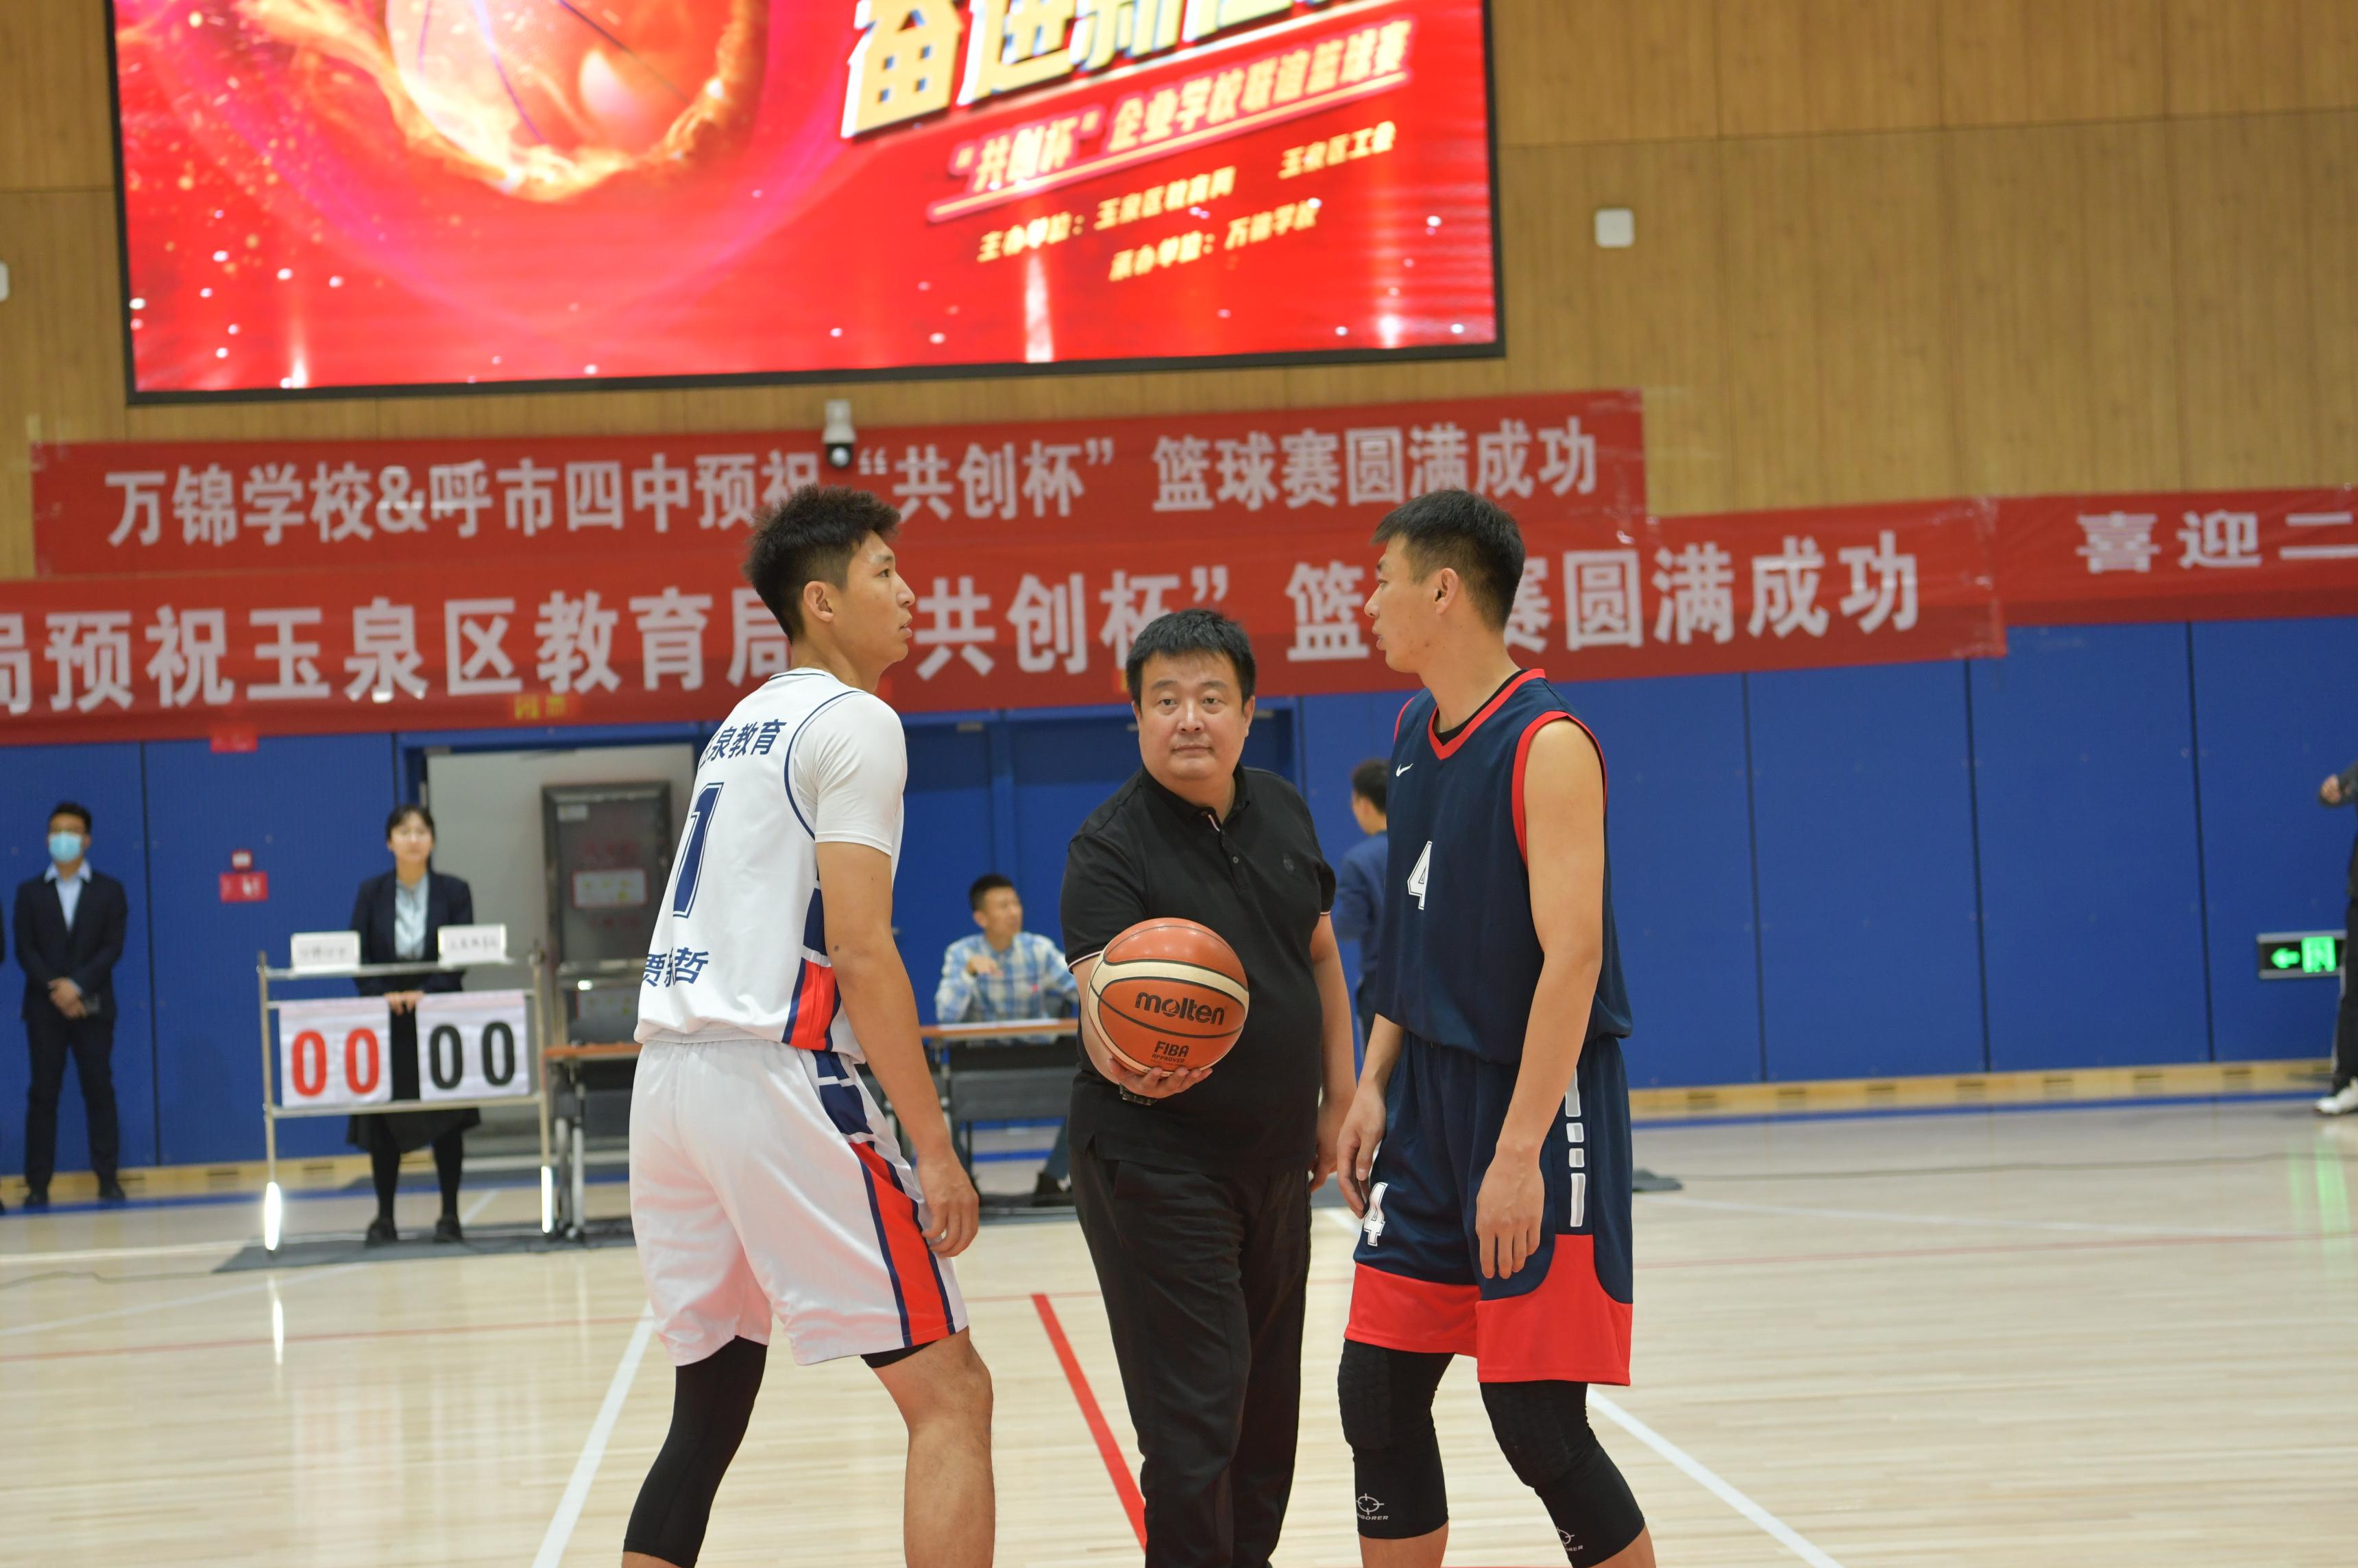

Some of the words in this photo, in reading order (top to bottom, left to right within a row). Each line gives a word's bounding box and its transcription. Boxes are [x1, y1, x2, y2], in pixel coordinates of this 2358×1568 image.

[672, 782, 725, 919] 1
[1407, 840, 1433, 910] 4
[1135, 992, 1226, 1026] molten
[1152, 1053, 1186, 1063] APPROVED
[1154, 1040, 1190, 1057] FIBA
[1363, 1181, 1389, 1247] 4
